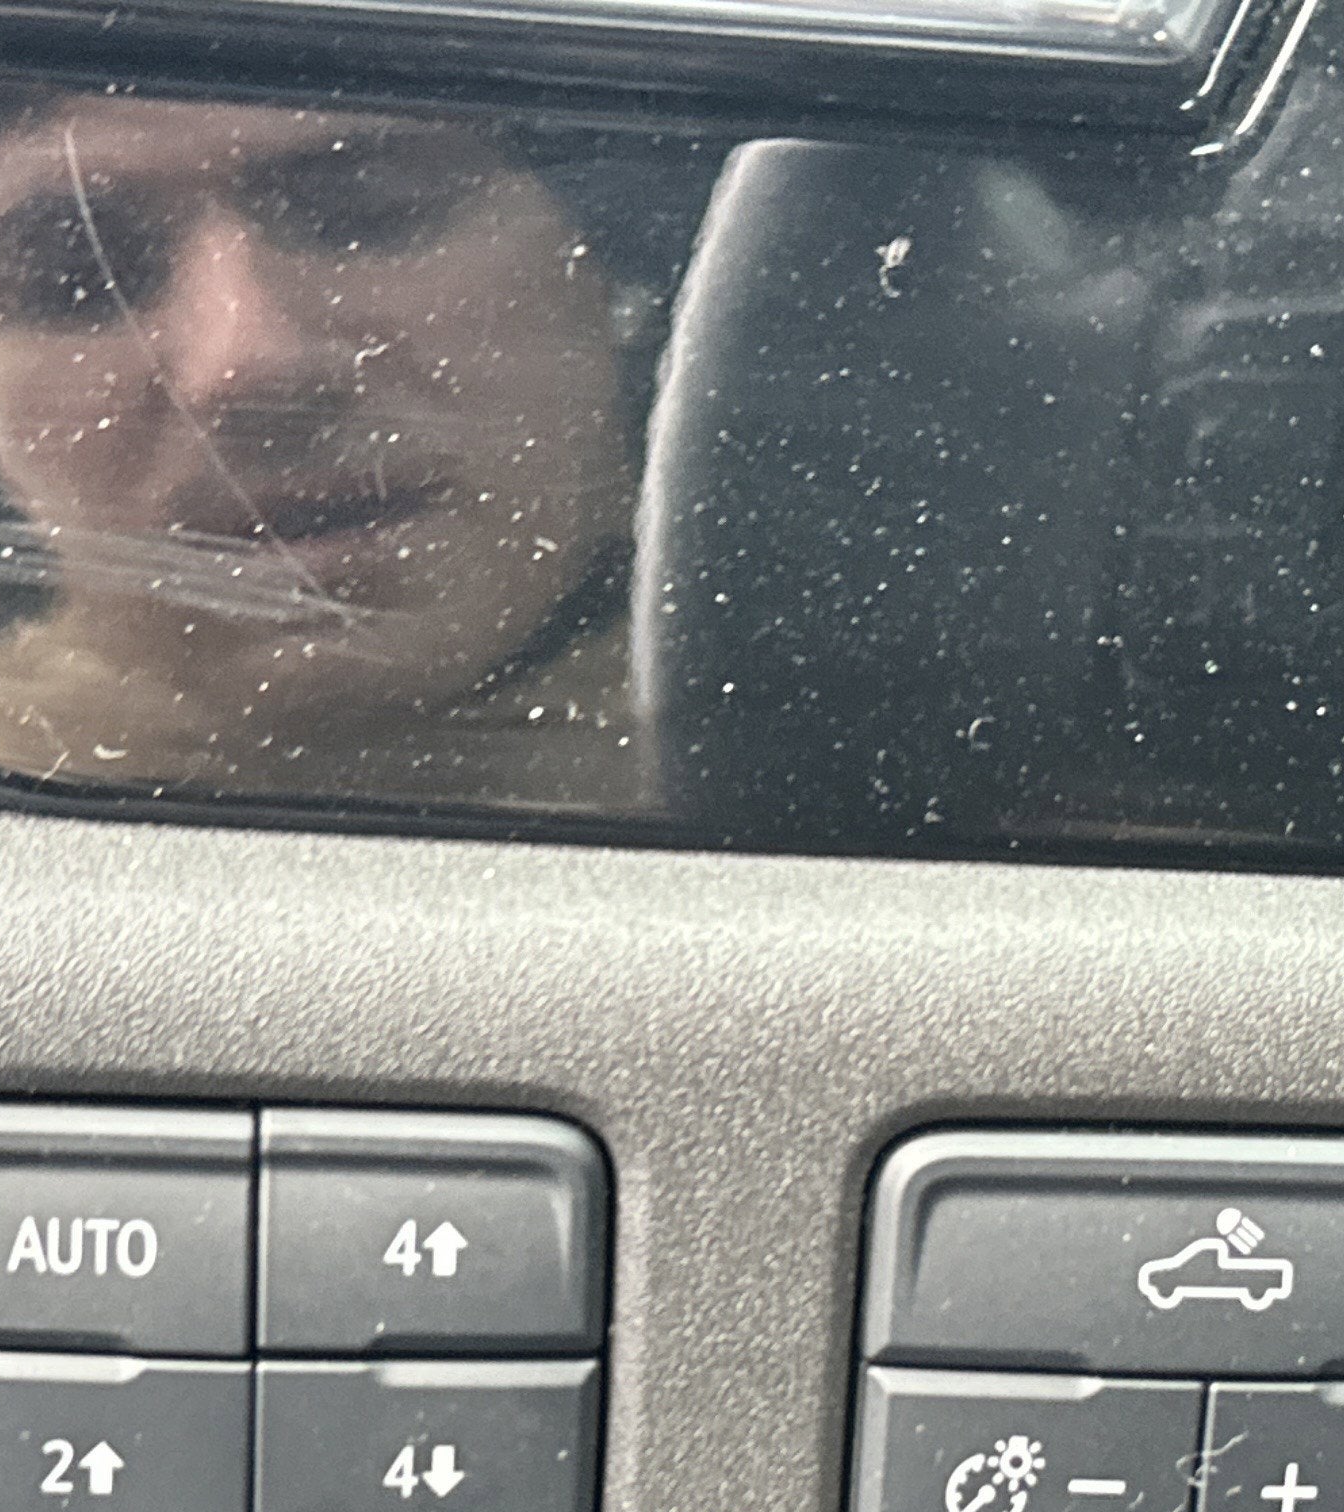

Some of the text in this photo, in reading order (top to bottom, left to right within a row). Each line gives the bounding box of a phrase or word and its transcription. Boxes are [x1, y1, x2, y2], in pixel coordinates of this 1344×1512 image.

[7, 1216, 158, 1278] AUTO
[384, 1220, 420, 1276] 4
[42, 1440, 75, 1495] 2
[383, 1445, 417, 1498] 4
